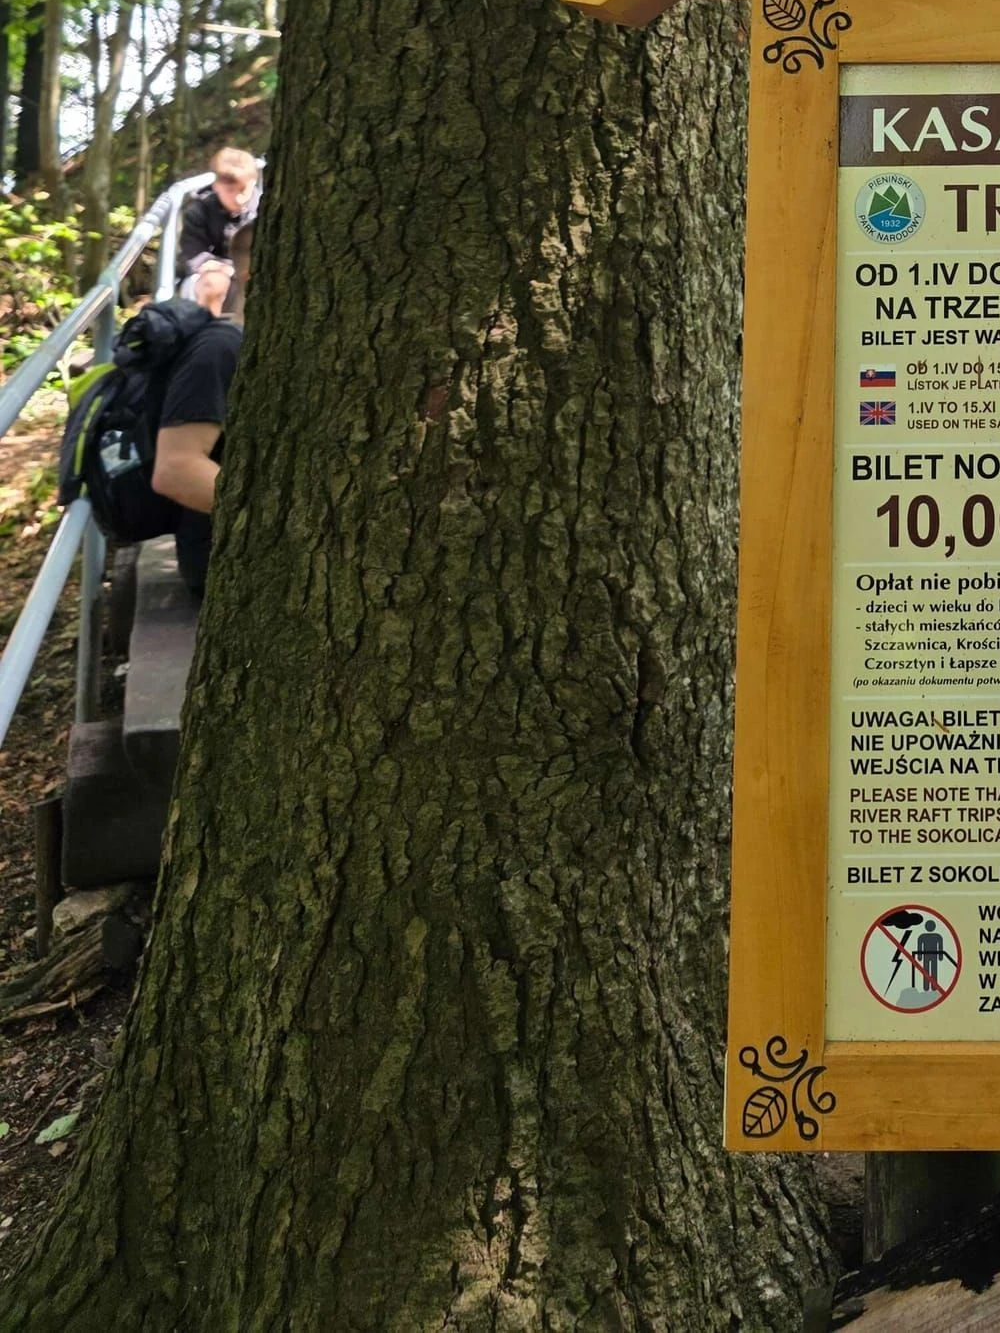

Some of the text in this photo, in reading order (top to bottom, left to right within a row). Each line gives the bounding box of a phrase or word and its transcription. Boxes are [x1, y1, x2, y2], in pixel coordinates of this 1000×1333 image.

[868, 175, 912, 189] PIENIŃSKI
[858, 214, 921, 241] PARK NARODOWY
[856, 264, 897, 286] OD
[909, 263, 959, 285] 1.IV
[877, 297, 916, 319] NA
[862, 331, 916, 346] BILET
[922, 330, 969, 345] JEST
[909, 402, 933, 413] 1.IV
[938, 402, 958, 413] TO
[963, 401, 995, 413] 15.XI
[853, 455, 943, 480] BILET
[857, 573, 913, 596] Opłat
[921, 573, 950, 590] nie
[866, 600, 907, 613] dzieci
[913, 604, 924, 612] w
[930, 600, 971, 612] wieku
[976, 600, 993, 611] do
[865, 638, 951, 652] Szczawnica,
[852, 711, 935, 728] UWAGA!
[851, 788, 917, 802] PLEASE
[924, 788, 969, 802] NOTE
[848, 867, 904, 883] BILET
[911, 867, 922, 882] Z
[979, 974, 996, 989] W
